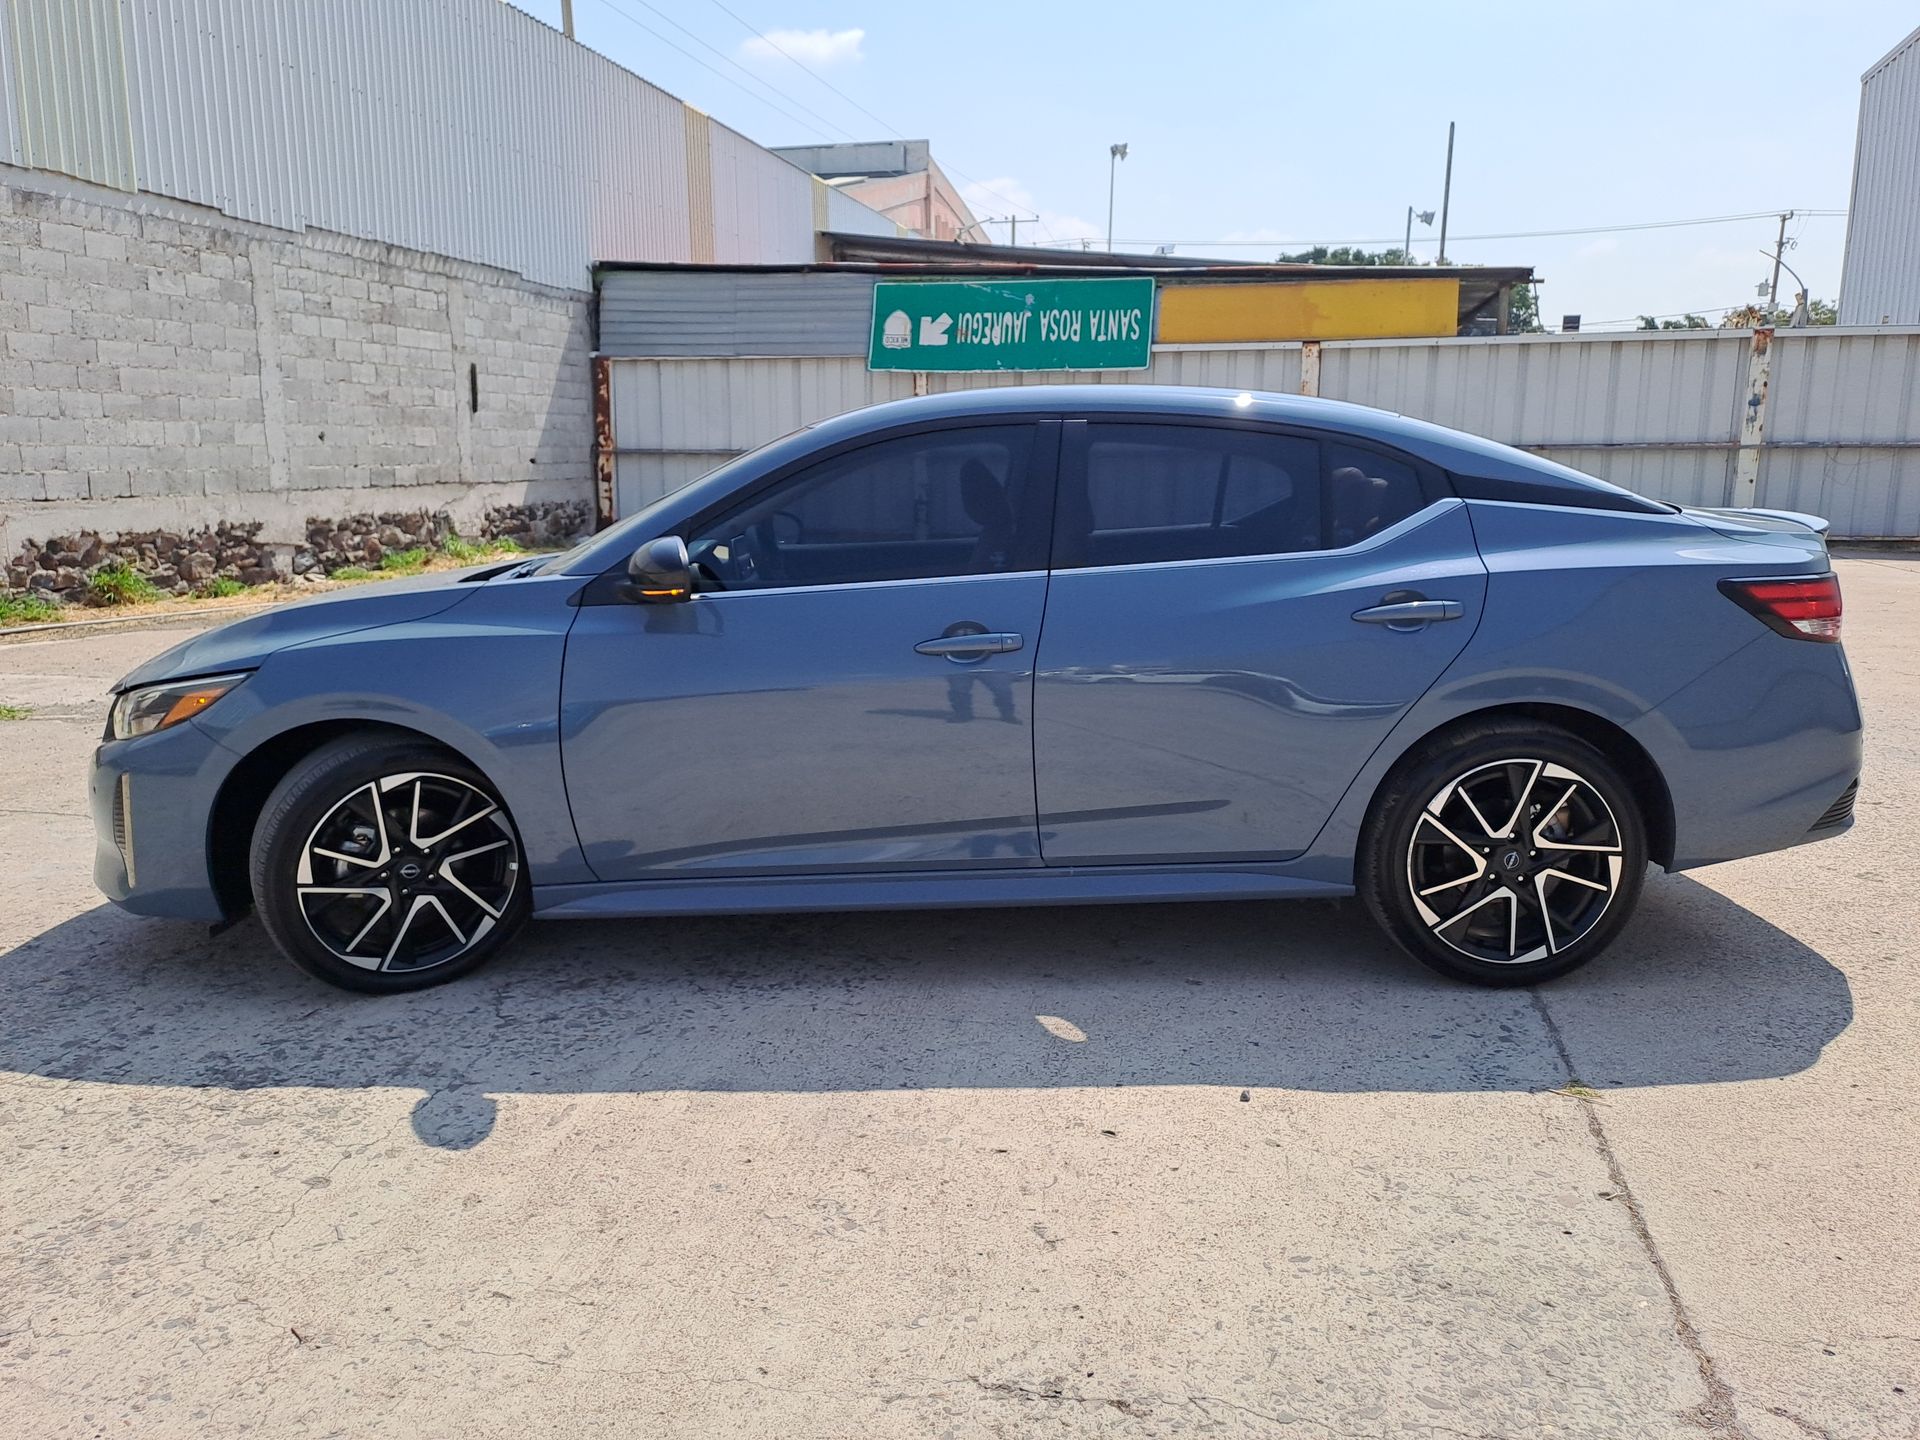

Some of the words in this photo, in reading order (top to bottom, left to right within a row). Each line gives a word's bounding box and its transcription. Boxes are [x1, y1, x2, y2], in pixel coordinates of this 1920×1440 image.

[956, 310, 1032, 346] JAUREGUI
[1039, 309, 1082, 342] ROSA
[1090, 308, 1142, 342] SANTA
